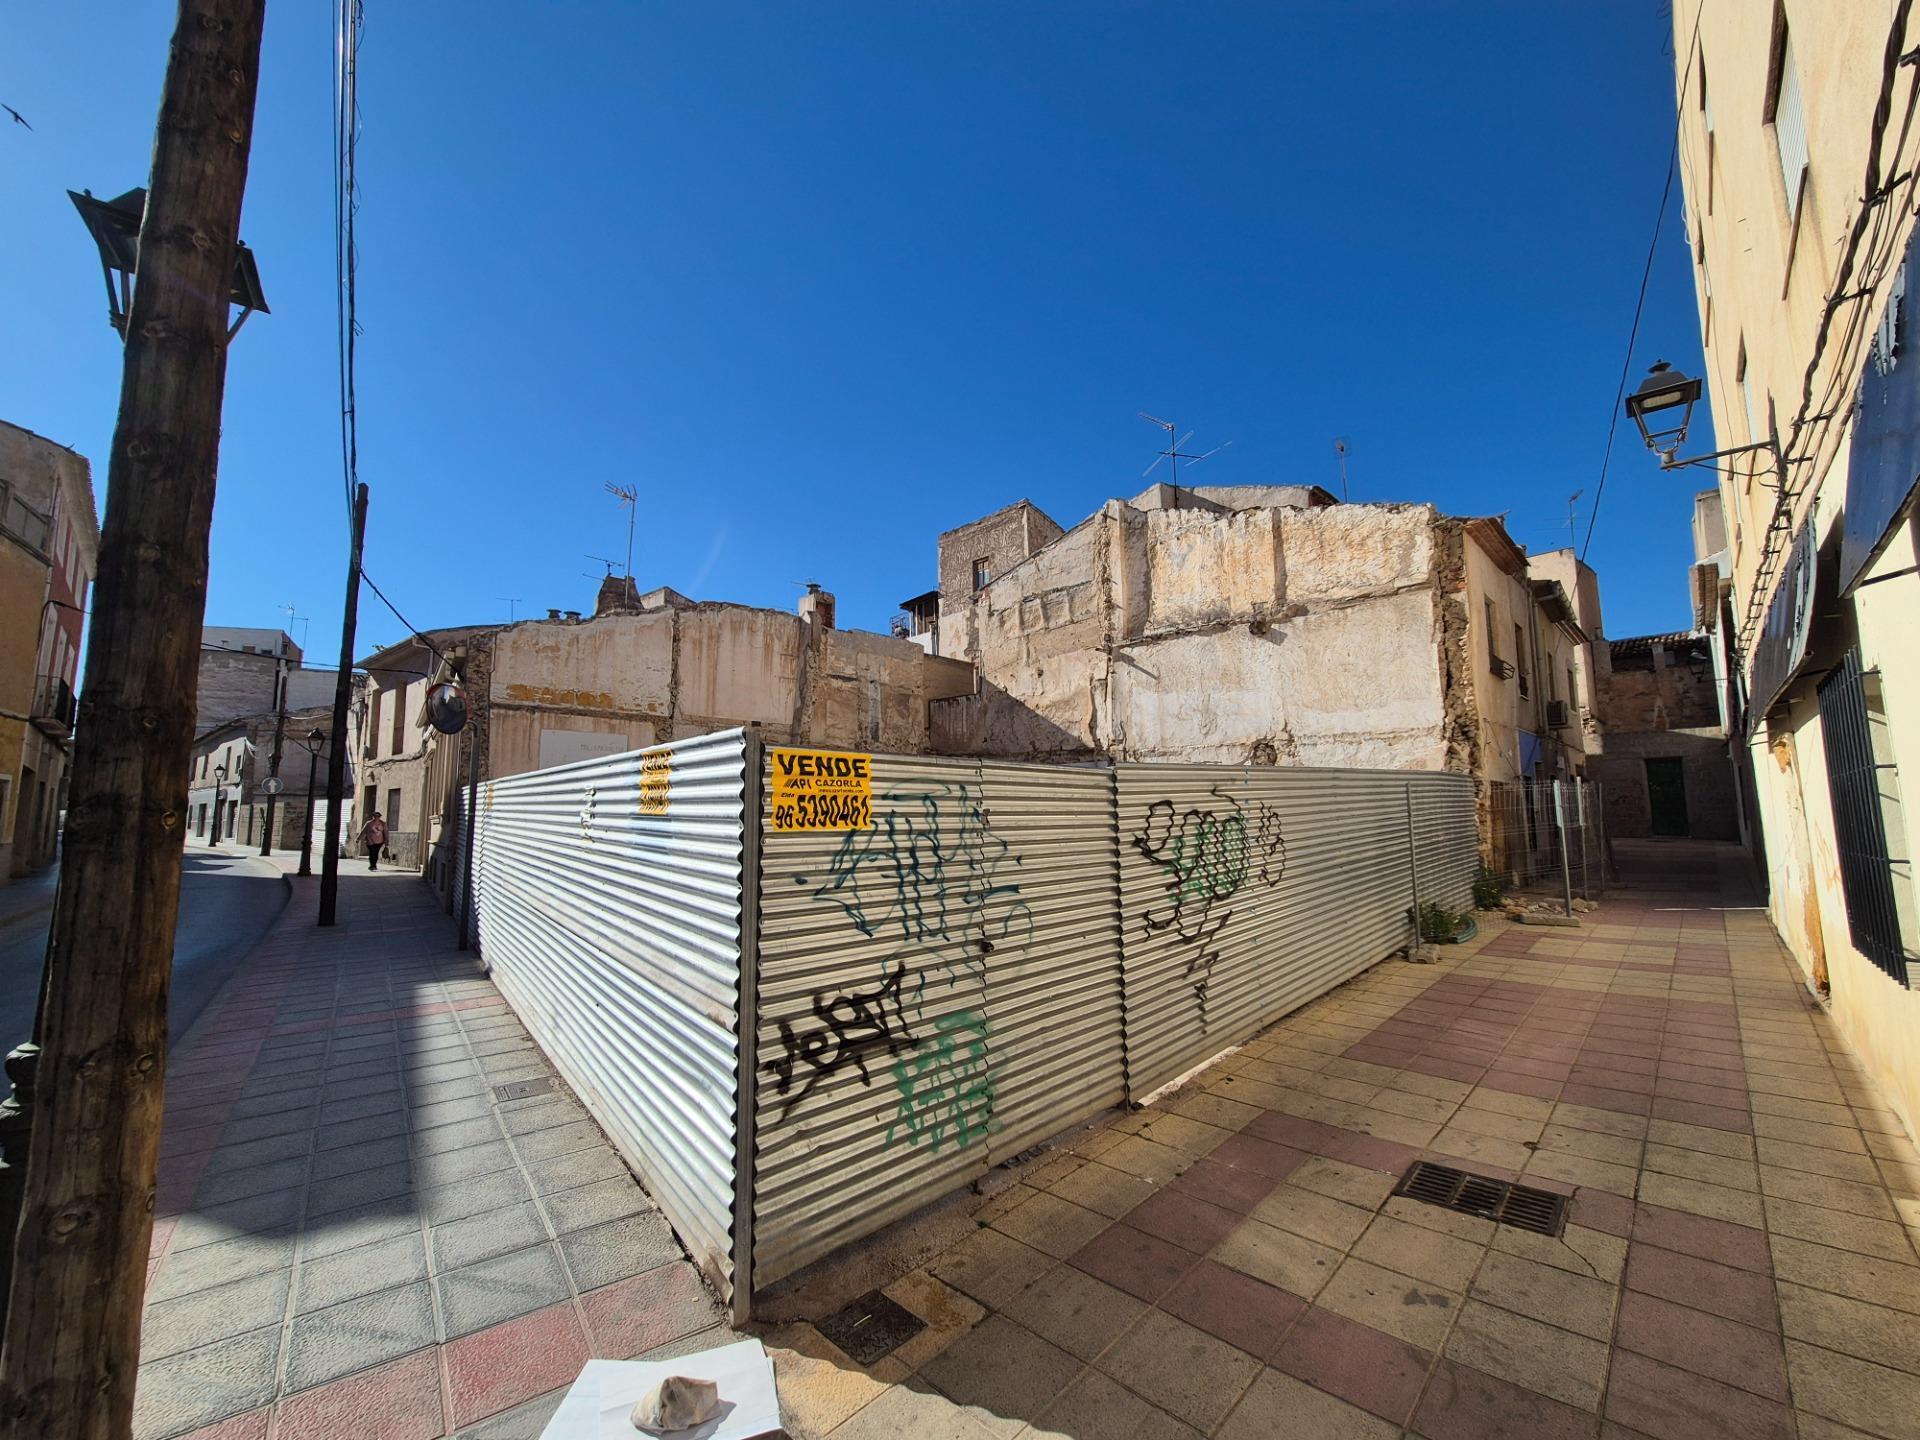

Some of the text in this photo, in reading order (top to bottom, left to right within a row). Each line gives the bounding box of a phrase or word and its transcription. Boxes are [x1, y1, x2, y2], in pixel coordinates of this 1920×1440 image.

[777, 754, 868, 778] VENDE
[789, 778, 862, 789] API CAZORLA
[775, 794, 869, 829] 96 5390461
